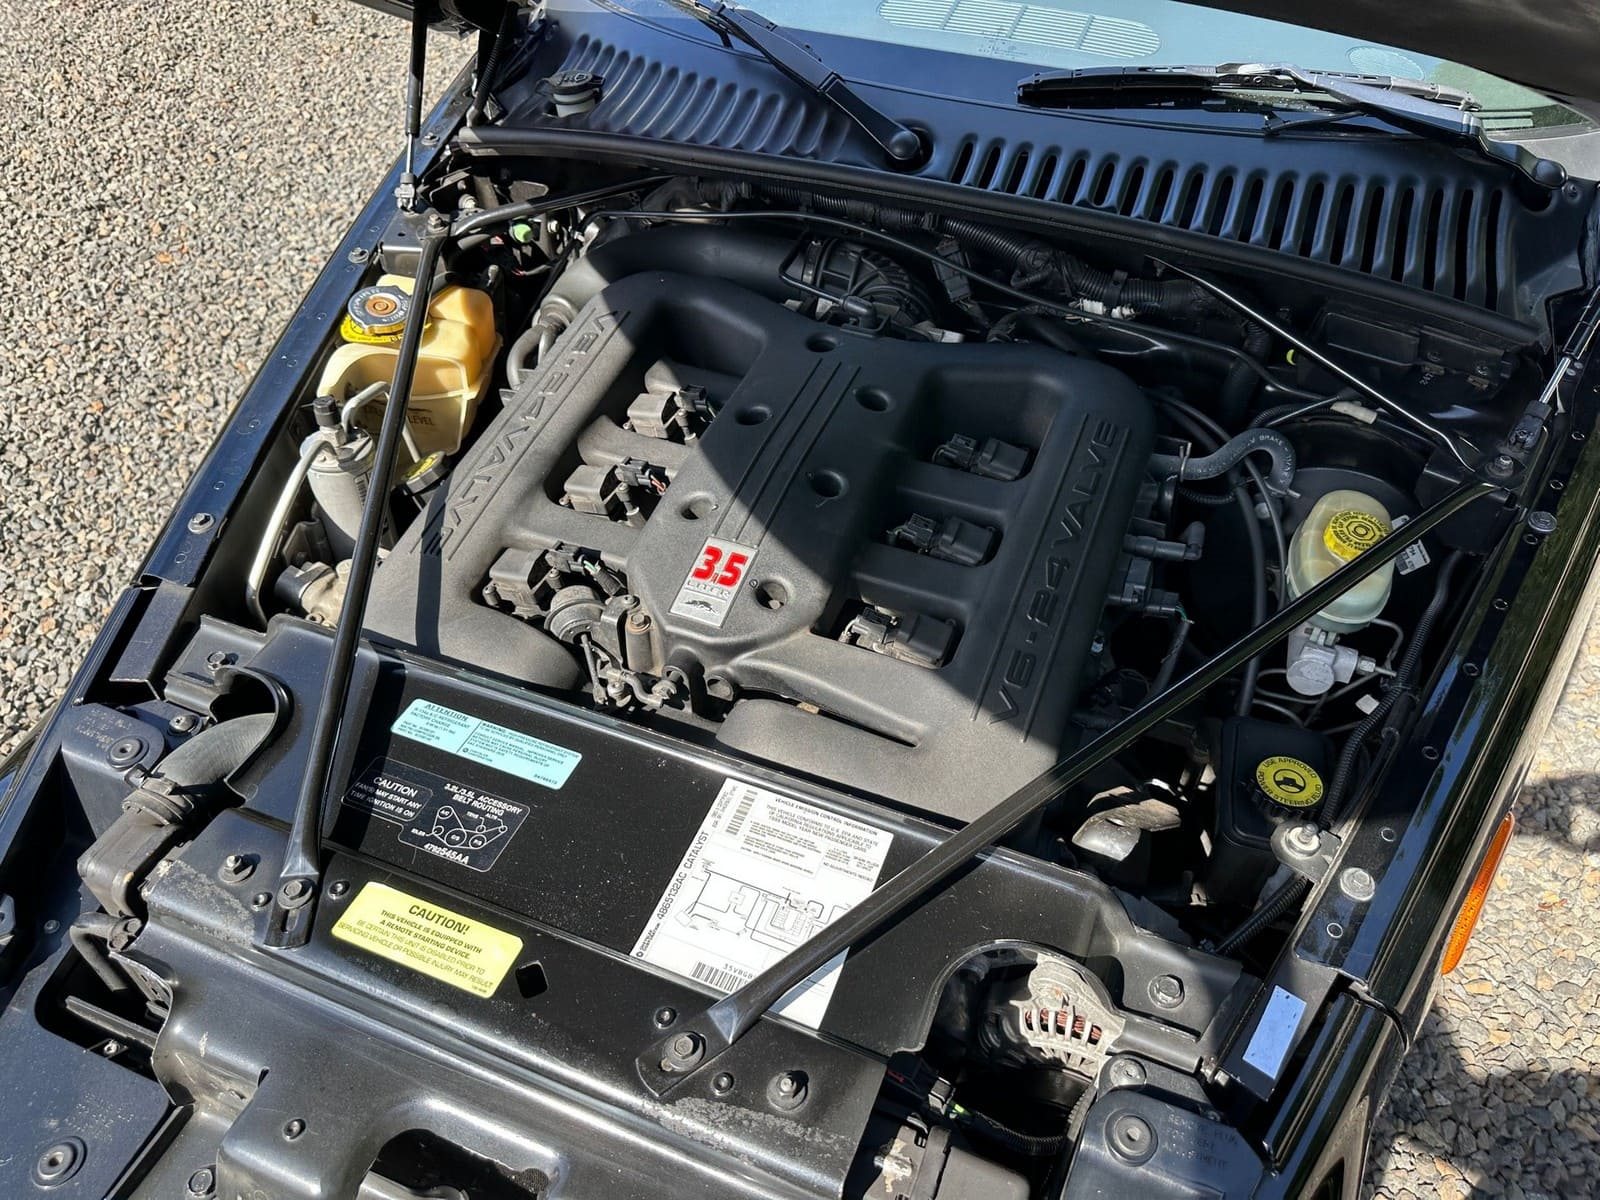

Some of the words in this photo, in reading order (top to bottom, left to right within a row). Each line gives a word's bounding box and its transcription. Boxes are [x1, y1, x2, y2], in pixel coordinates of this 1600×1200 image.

[408, 415, 434, 426] LEVEL
[422, 426, 530, 556] VALVE
[1051, 421, 1117, 549] VALVE
[424, 703, 468, 721] ATTENTION
[1263, 759, 1274, 768] USE
[1278, 758, 1317, 778] APPROVED
[374, 777, 417, 797] CAUTION
[374, 788, 389, 797] MAY
[387, 793, 408, 804] START
[406, 800, 422, 809] ANY
[1258, 770, 1273, 794] POWER
[1274, 794, 1313, 805] STEERING
[1311, 784, 1322, 800] FLUID
[366, 796, 395, 810] IGNITION
[402, 809, 415, 817] ON
[452, 793, 472, 804] BELT
[471, 800, 504, 815] ROUTING
[477, 795, 522, 814] ACCESSORY
[775, 798, 794, 807] VEHICLE
[819, 812, 842, 823] CONTROL
[843, 820, 878, 835] INFORMATION
[684, 831, 709, 870] CATALYST
[380, 910, 394, 919] THIS
[395, 916, 422, 930] VEHICLE
[430, 930, 463, 946] EQUIPPED
[463, 942, 482, 953] WITH
[407, 904, 470, 934] CAUTION!
[385, 921, 413, 936] REMOTE
[412, 932, 446, 948] STARTING
[337, 921, 370, 938] SERVICING
[368, 934, 393, 948] VEHICLE
[392, 943, 403, 952] OR
[401, 947, 431, 963] POSSIBLE
[430, 959, 455, 973] INJURY
[454, 968, 469, 979] MAY
[365, 923, 390, 937] CERTAIN
[390, 933, 404, 942] THIS
[404, 938, 419, 948] UNIT
[425, 947, 456, 963] DISABLED
[455, 959, 476, 971] PRIOR
[475, 967, 485, 975] TO
